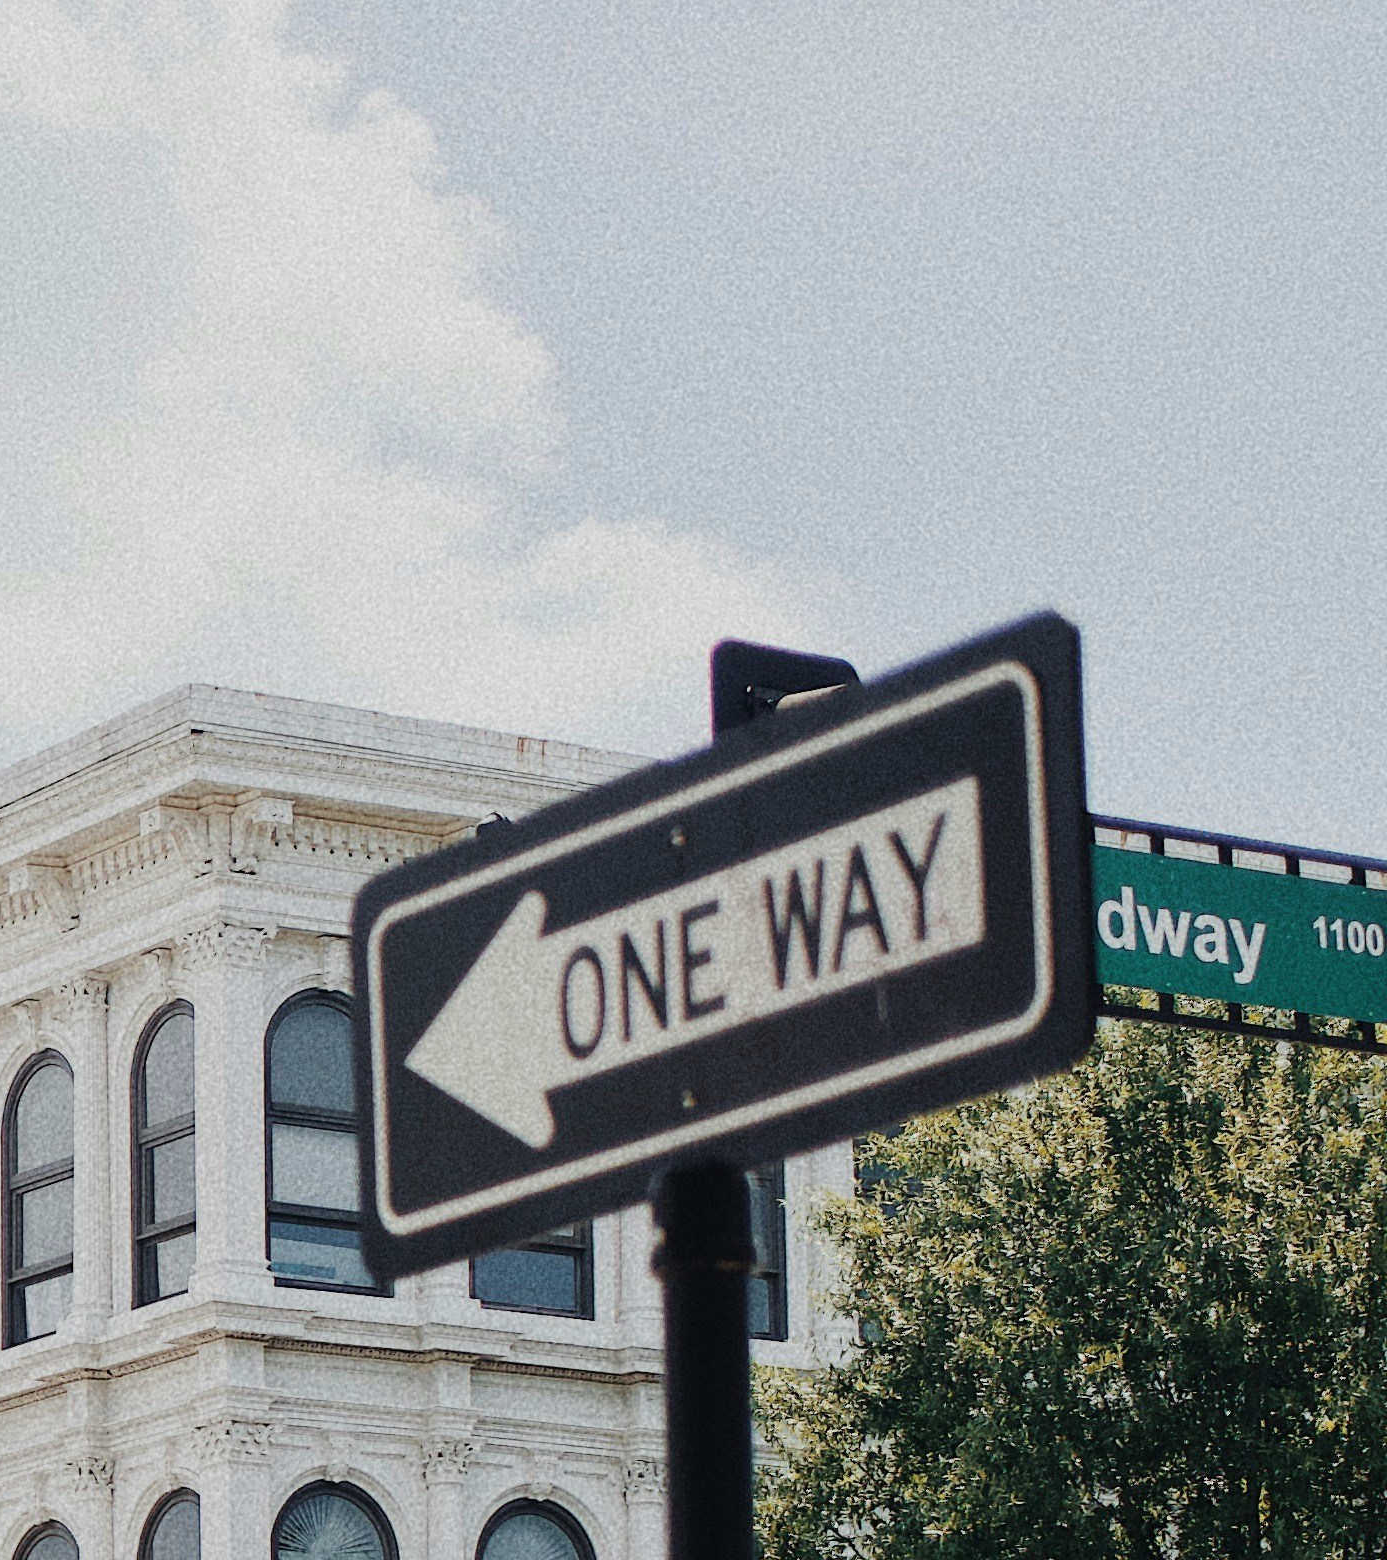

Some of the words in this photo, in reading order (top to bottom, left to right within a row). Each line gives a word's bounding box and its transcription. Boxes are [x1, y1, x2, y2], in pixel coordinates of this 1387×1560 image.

[562, 899, 725, 1060] ONE
[764, 812, 946, 990] WAY
[1096, 885, 1268, 985] dway
[1312, 915, 1386, 957] 1100
